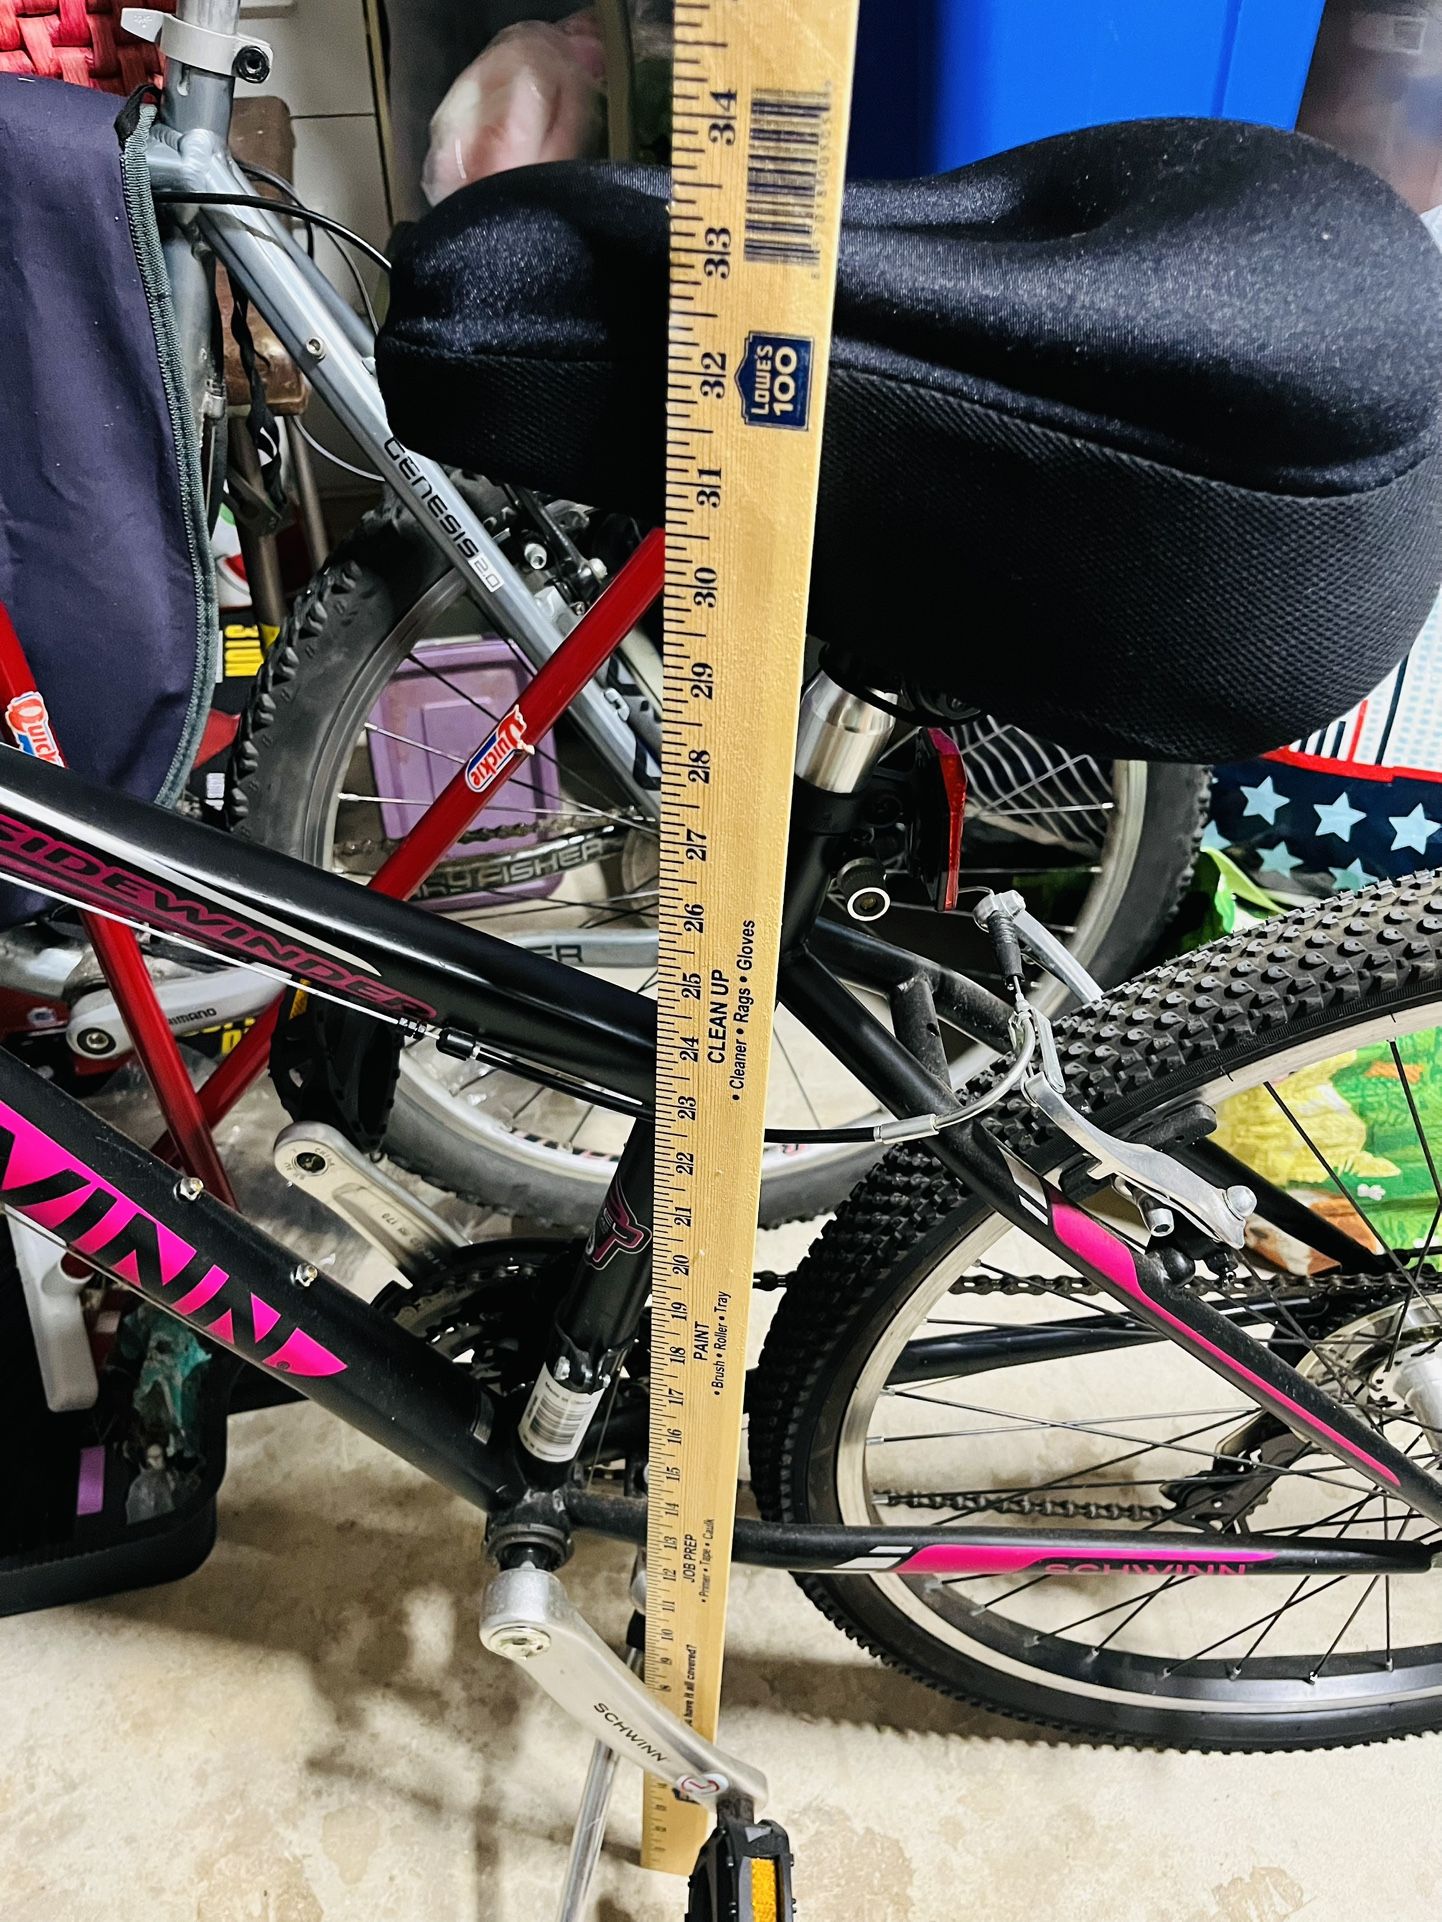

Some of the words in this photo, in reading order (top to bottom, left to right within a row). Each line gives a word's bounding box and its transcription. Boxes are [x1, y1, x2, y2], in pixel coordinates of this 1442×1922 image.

[708, 89, 737, 146] 34
[704, 227, 731, 280] 33
[700, 352, 727, 400] 32
[751, 345, 773, 415] LOWE'S
[773, 346, 797, 416] 100
[697, 467, 722, 508] 31
[384, 437, 479, 559] GENESIS
[474, 558, 501, 588] 2.0
[693, 567, 718, 608] 30
[690, 661, 714, 700] 29
[9, 698, 57, 762] Quick
[470, 708, 527, 787] Quickie
[687, 749, 711, 785] 28
[685, 828, 708, 861] 27
[684, 903, 705, 933] 26
[736, 919, 756, 971] Gloves
[681, 972, 702, 1000] 25
[711, 969, 729, 998] UP
[733, 987, 755, 1024] Rags
[707, 1001, 728, 1064] CLEAN
[680, 1037, 700, 1063] 24
[729, 1039, 748, 1090] Cleaner
[677, 1095, 697, 1121] 23
[676, 1152, 694, 1176] 22
[674, 1206, 692, 1228] 21
[672, 1254, 690, 1276] 20
[671, 1301, 688, 1321] 19
[714, 1291, 731, 1315] Tray
[693, 1321, 710, 1361] PAINT
[714, 1323, 728, 1351] Roller
[669, 1347, 686, 1366] 18
[711, 1356, 724, 1389] Brush
[668, 1387, 684, 1406] 17
[667, 1429, 682, 1445] 16
[666, 1467, 680, 1482] 15
[665, 1502, 679, 1516] 14
[664, 1536, 677, 1550] 13
[683, 1534, 697, 1561] PREP
[663, 1569, 676, 1581] 12
[683, 1563, 696, 1583] JOB
[662, 1600, 675, 1612] 11
[661, 1629, 673, 1641] 10
[594, 1702, 667, 1763] SCHWINN
